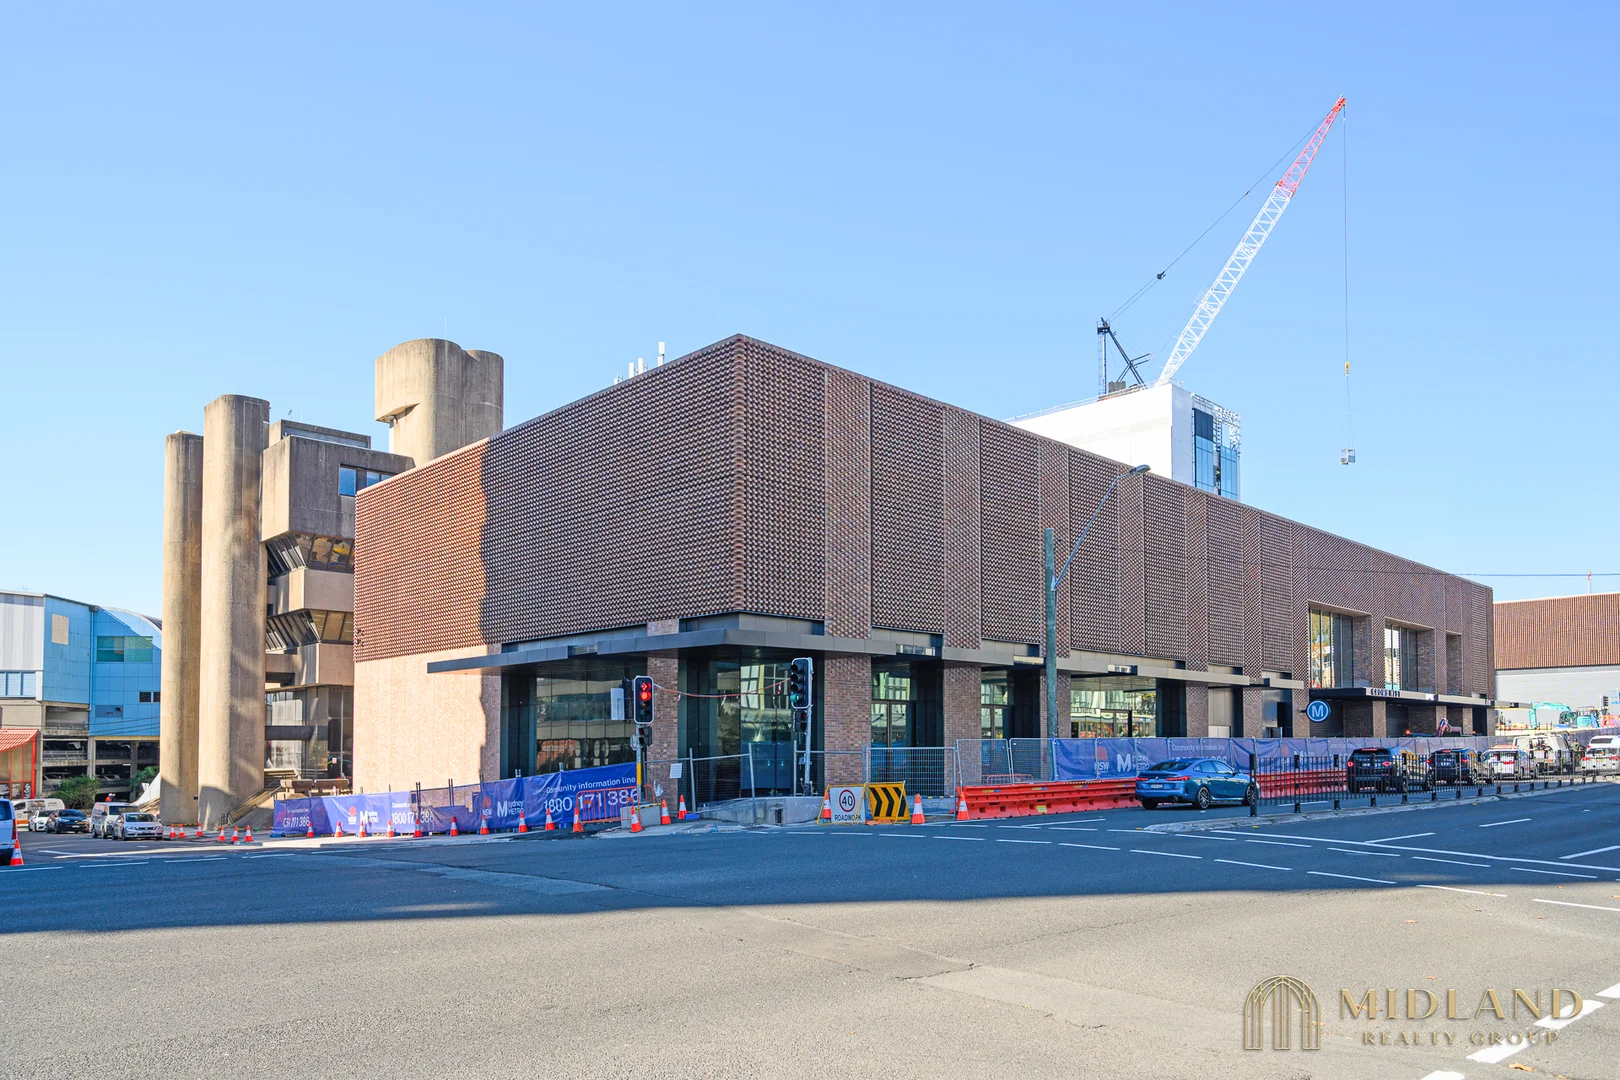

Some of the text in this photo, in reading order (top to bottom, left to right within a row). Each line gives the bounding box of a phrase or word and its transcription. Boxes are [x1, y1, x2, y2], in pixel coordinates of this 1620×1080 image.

[1311, 705, 1324, 718] M
[1171, 743, 1196, 752] Community
[1196, 743, 1217, 751] inormation
[1117, 753, 1132, 773] M
[546, 776, 636, 794] Counity information line
[544, 788, 638, 813] 1800 171 386
[842, 795, 853, 806] 40
[497, 800, 508, 817] M
[391, 812, 407, 824] 1800
